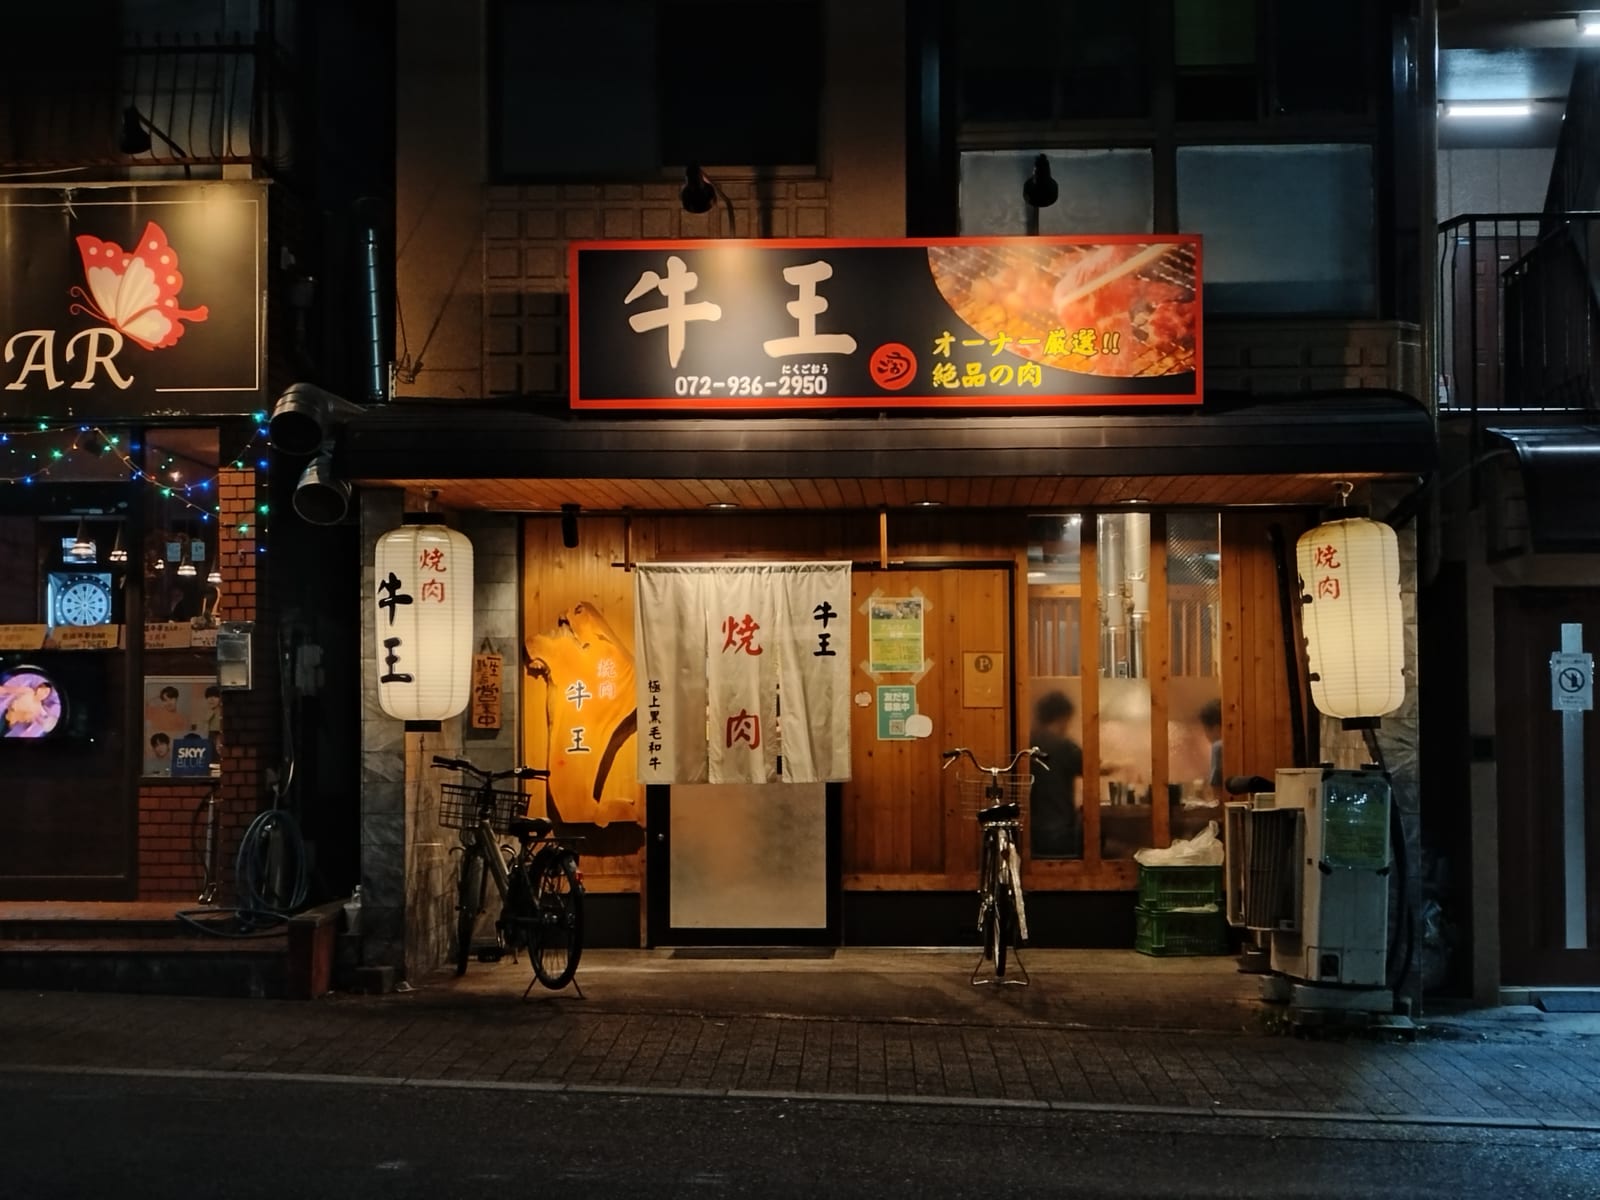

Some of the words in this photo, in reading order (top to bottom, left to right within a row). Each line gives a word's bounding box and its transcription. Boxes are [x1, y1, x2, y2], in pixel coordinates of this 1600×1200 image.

[624, 256, 857, 368] 牛王
[4, 328, 134, 391] AR
[782, 363, 829, 375] にくごおう
[933, 328, 1121, 357] オーナー厳選!!
[675, 375, 828, 396] 072-936-2950
[932, 361, 1042, 388] 絶品の肉
[419, 547, 447, 603] 焼肉
[1314, 544, 1341, 600] 焼肉
[377, 571, 415, 684] 牛王
[813, 601, 838, 657] 牛王
[721, 613, 763, 750] 焼肉
[567, 681, 592, 753] 牛王
[648, 680, 662, 771] 極上黒毛和牛
[177, 746, 207, 759] SKYY
